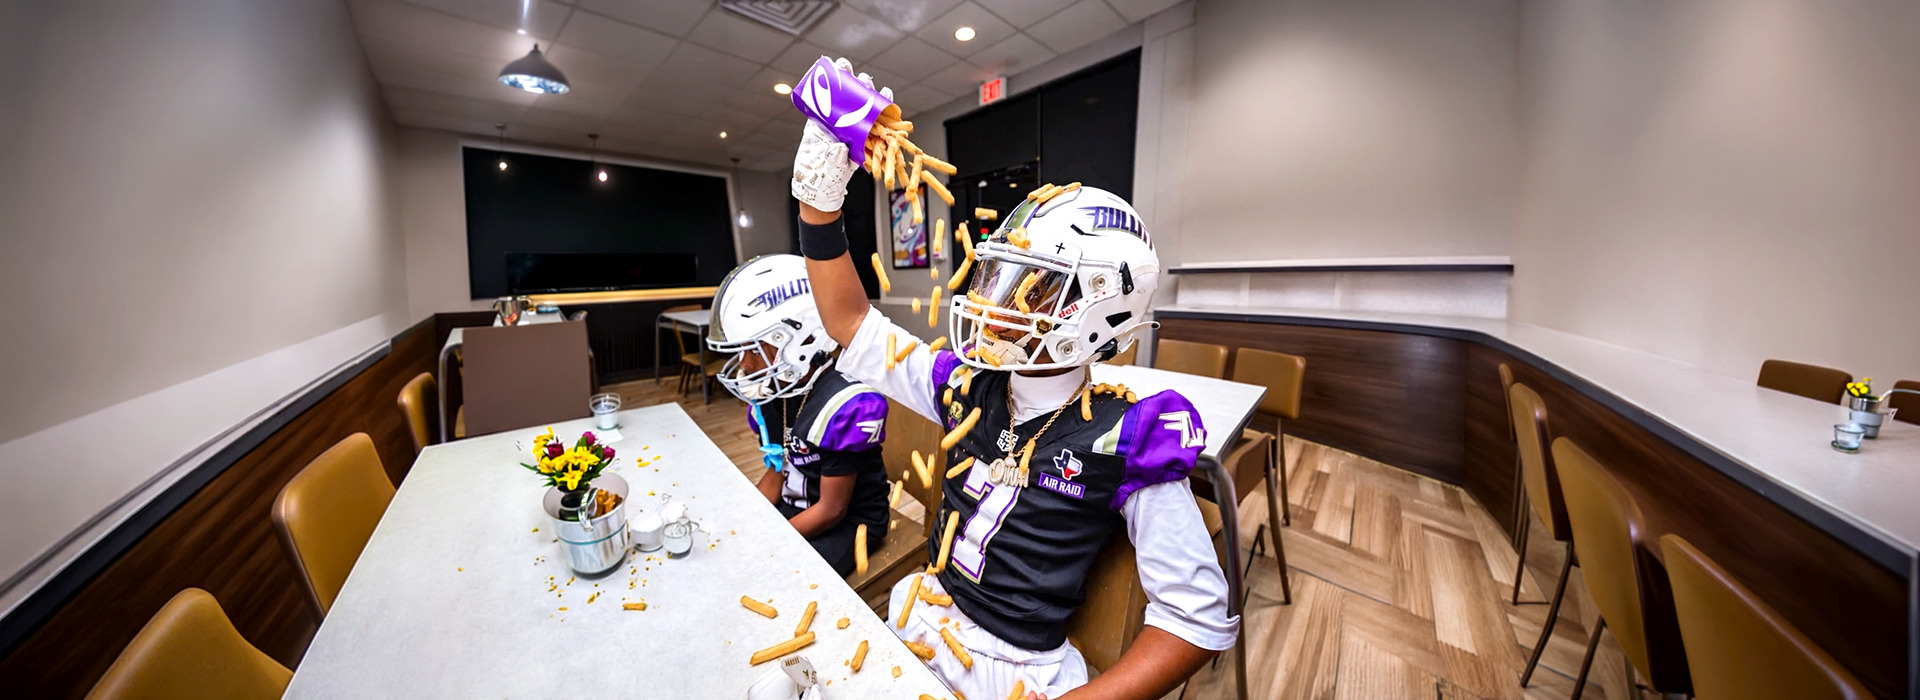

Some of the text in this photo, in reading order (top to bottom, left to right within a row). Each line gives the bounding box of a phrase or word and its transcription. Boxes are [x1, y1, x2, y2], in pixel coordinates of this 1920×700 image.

[983, 79, 1002, 103] EXIT
[793, 453, 821, 466] AIR RAID
[1042, 476, 1082, 496] AIR RAID
